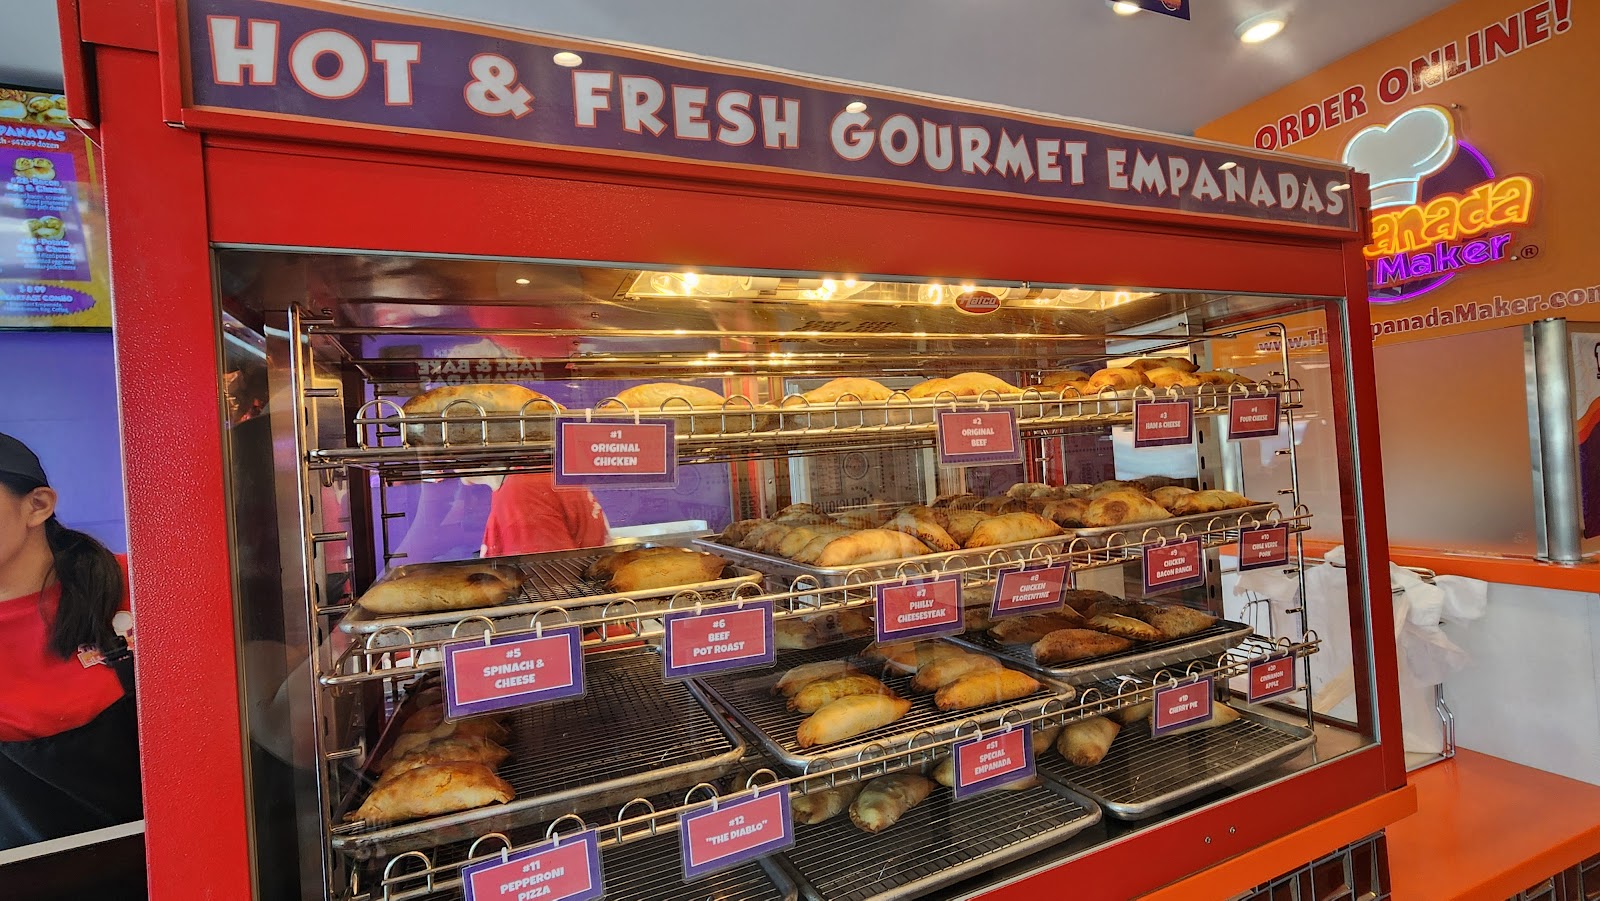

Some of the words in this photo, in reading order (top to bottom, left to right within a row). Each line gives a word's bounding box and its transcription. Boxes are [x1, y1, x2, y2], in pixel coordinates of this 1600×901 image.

[1254, 84, 1367, 151] ORDER
[1377, 0, 1573, 104] ONLINE!
[206, 15, 421, 106] HOT
[463, 53, 534, 119] &
[571, 69, 800, 149] FRESH
[829, 106, 1088, 185] GOURMET
[1106, 148, 1345, 215] EMPANADAS
[37, 140, 60, 149] dozen
[1363, 176, 1534, 257] anada
[1376, 232, 1512, 285] Maker
[972, 417, 983, 425] #2
[1239, 415, 1252, 423] FOUR
[1252, 414, 1268, 422] CHEESE
[1145, 422, 1158, 430] HAM
[1163, 420, 1181, 429] CHEESE
[609, 430, 622, 439] #1
[961, 427, 995, 437] ORIGINAL
[590, 443, 640, 453] ORIGINAL
[971, 439, 987, 447] BEEF
[593, 456, 638, 467] CHICKEN
[1264, 541, 1278, 549] VERDE
[1163, 557, 1185, 568] CHICKEN
[1156, 567, 1174, 578] BACON
[1174, 565, 1192, 576] RANCH
[1019, 582, 1046, 591] CHICKEN
[916, 589, 927, 598] #7
[1011, 591, 1051, 603] FLORENTINE
[909, 600, 934, 611] PHILLY
[897, 609, 946, 624] CHEESESTEAK
[712, 619, 726, 629] #6
[708, 631, 730, 643] BEEF
[505, 648, 521, 659] #5
[693, 645, 713, 657] POT
[713, 641, 745, 654] ROAST
[483, 660, 534, 677] SPINACH
[535, 659, 545, 669] &
[494, 674, 536, 689] CHEESE
[1260, 671, 1284, 682] CINNAMON
[1265, 681, 1279, 690] APPLE
[1169, 704, 1189, 715] CHERRY
[1189, 701, 1198, 710] PIE
[979, 749, 1006, 763] SPECIAL
[974, 757, 1012, 775] EMPANADA
[728, 815, 744, 826] #12
[705, 832, 730, 847] "THE
[730, 820, 768, 840] DIABLO"
[522, 860, 541, 872] #11
[500, 867, 565, 895] PEPPERONI
[517, 886, 551, 901] PIZZA
